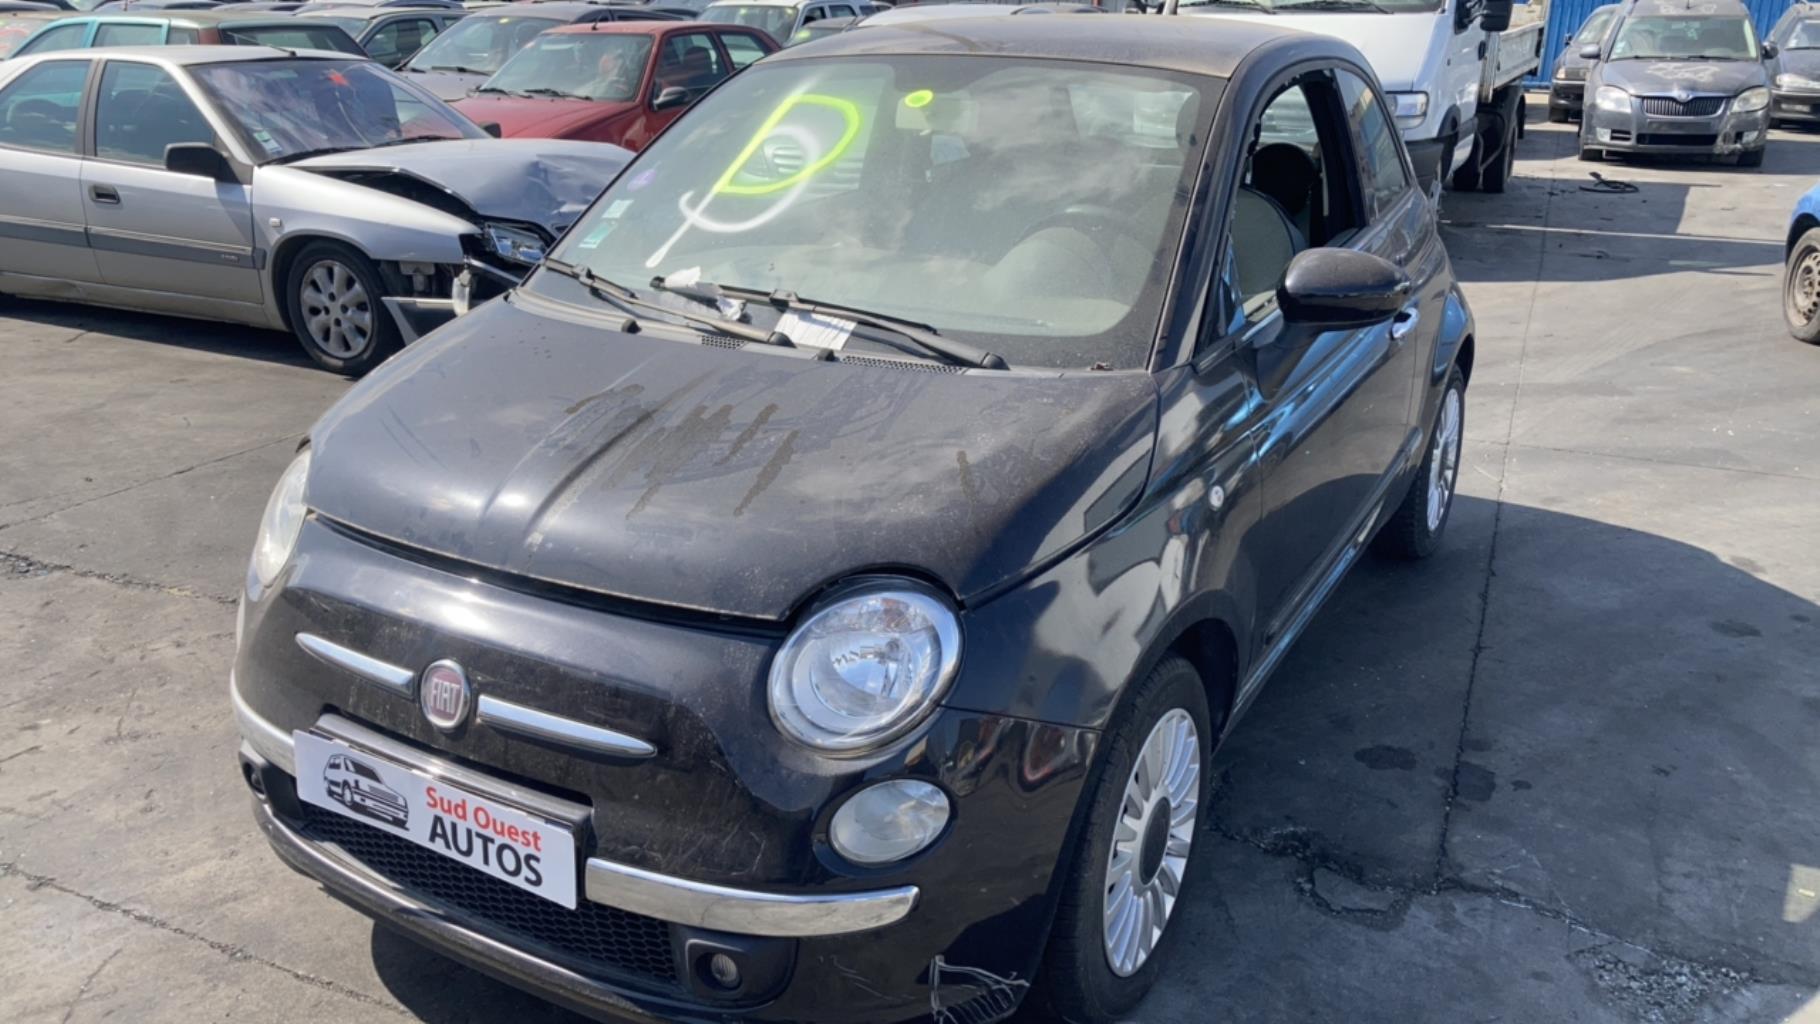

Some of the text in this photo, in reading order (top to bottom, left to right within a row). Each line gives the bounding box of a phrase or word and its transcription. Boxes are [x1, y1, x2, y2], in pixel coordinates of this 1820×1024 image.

[431, 677, 461, 715] FIAT
[426, 786, 542, 852] Sud Ouest
[428, 814, 543, 887] AUTOS
